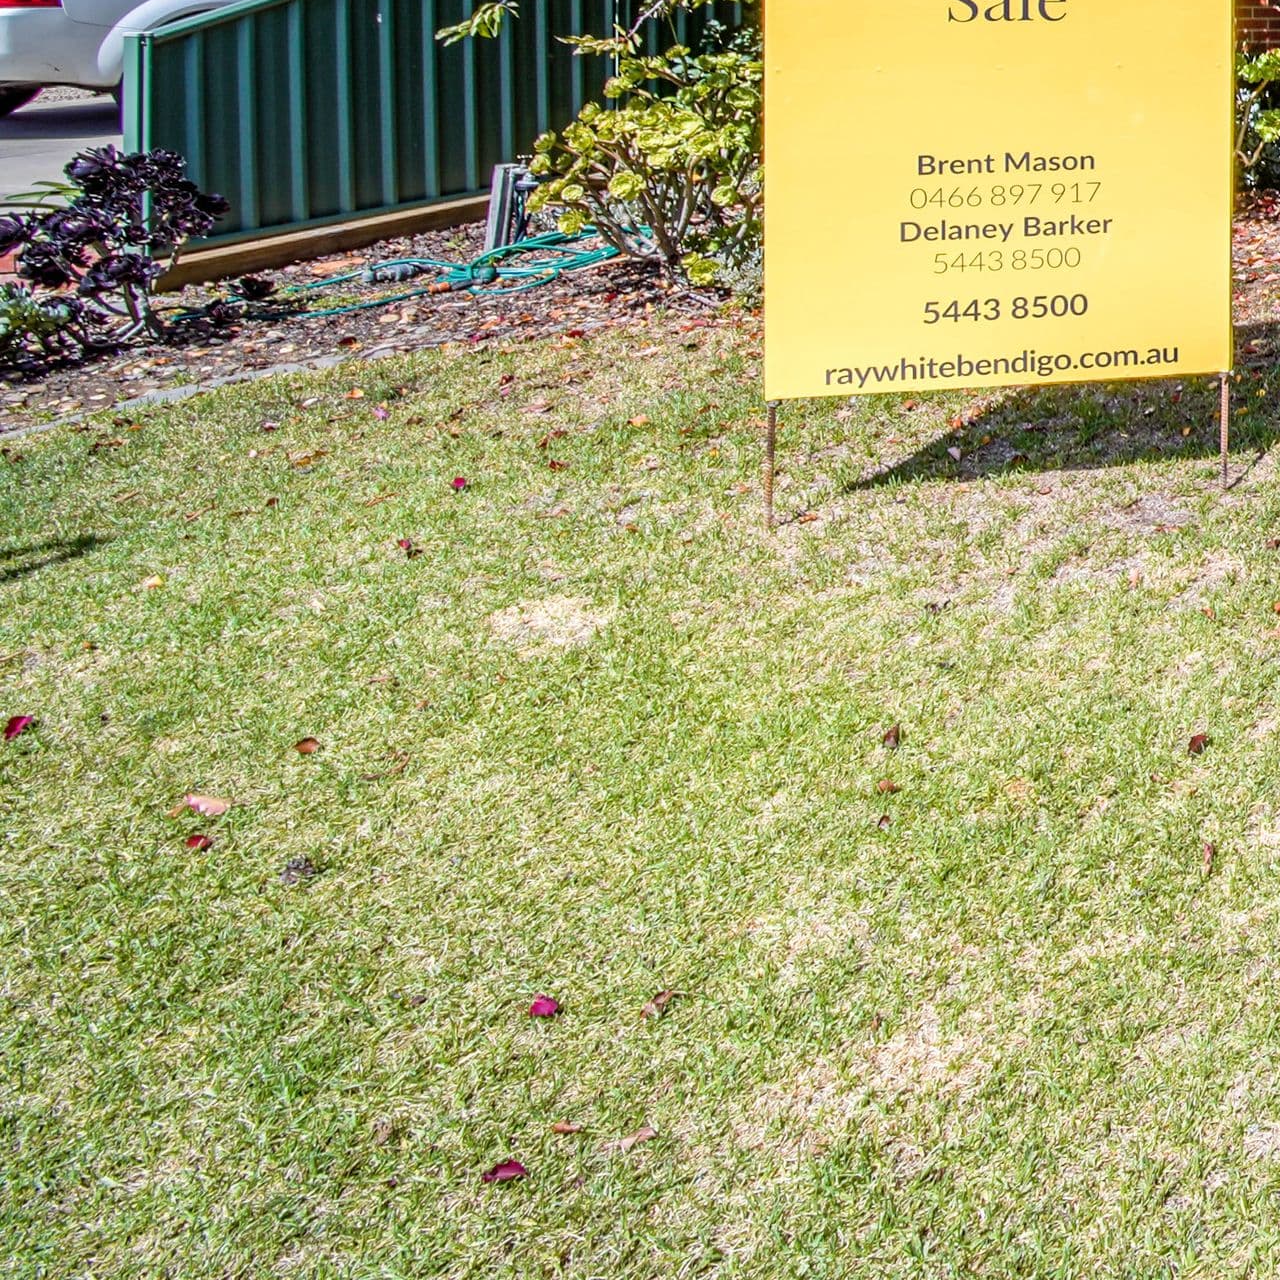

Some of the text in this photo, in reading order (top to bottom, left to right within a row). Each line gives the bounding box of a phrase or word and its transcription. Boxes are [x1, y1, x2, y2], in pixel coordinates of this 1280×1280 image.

[917, 151, 1096, 177] Brent Mason
[909, 181, 1103, 210] 0466 897 917
[899, 214, 1114, 244] Delaney Barker
[933, 246, 1082, 276] 5443 8500
[922, 292, 1090, 326] 5443 8500
[824, 345, 1180, 388] raywhitebendigo.com.au
